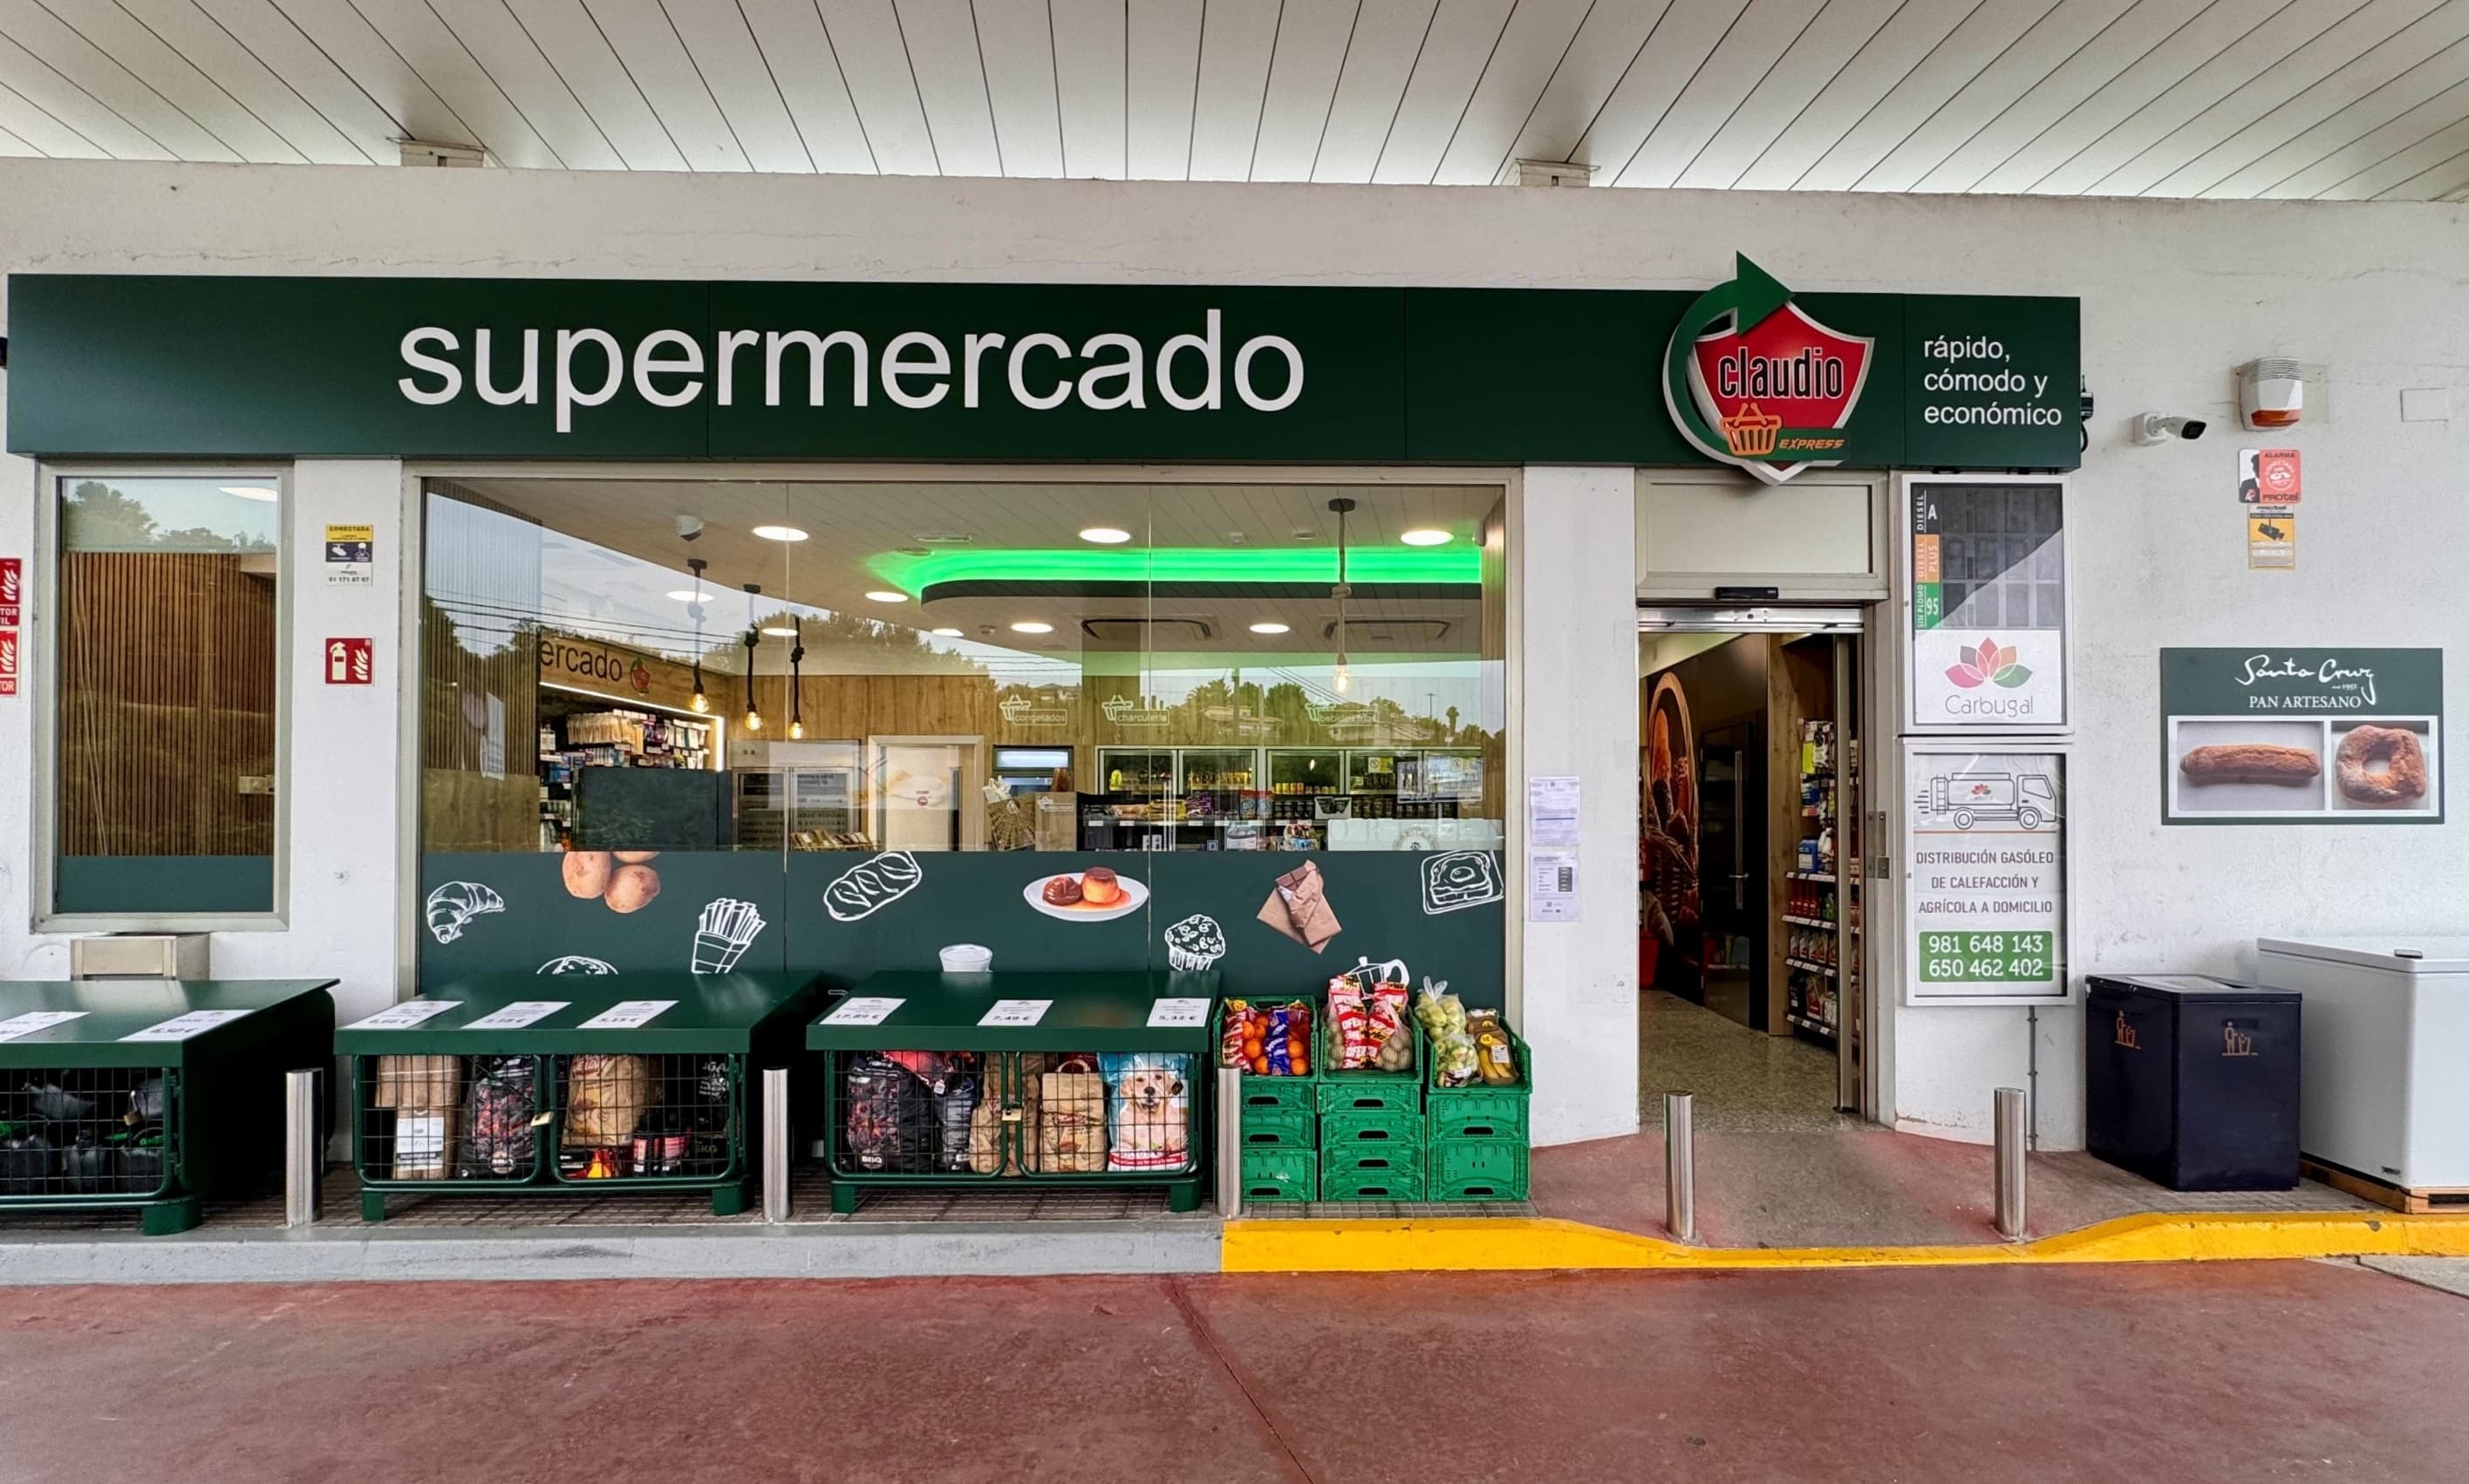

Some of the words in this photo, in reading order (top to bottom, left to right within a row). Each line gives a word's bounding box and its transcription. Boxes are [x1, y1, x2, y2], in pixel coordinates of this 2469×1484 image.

[1923, 335, 2011, 364] rápido,
[397, 308, 1305, 433] supermercado
[1717, 346, 1844, 398] claudio
[1923, 368, 2025, 392] cómodo
[2033, 371, 2048, 398] y
[1923, 400, 2063, 426] económico
[1778, 439, 1845, 451] EXPRESS
[1927, 504, 1938, 521] A
[1928, 545, 1938, 573] PLUS
[1927, 597, 1939, 616] 95
[2234, 654, 2316, 685] Santa
[2318, 658, 2377, 705] Cruz
[1945, 695, 2034, 717] Carbugal
[2249, 696, 2278, 708] PAN
[2282, 696, 2362, 708] ARTESANO
[1015, 713, 1066, 724] congelados
[1916, 849, 1996, 863] DISTRIBUCIÓN
[2001, 848, 2054, 863] GASÓLEO
[1931, 877, 1947, 888] DE
[1950, 874, 2028, 888] CALEFACCIÓN
[2032, 877, 2038, 888] Y
[1919, 899, 1976, 913] AGRÍCOLA
[1981, 902, 1989, 913] A
[1993, 901, 2052, 913] DOMICILIO
[1928, 936, 1961, 953] 981
[1969, 936, 2002, 952] 648
[2012, 935, 2043, 952] 143
[1928, 959, 1962, 977] 650
[1969, 959, 2003, 976] 462
[2009, 959, 2043, 976] 402
